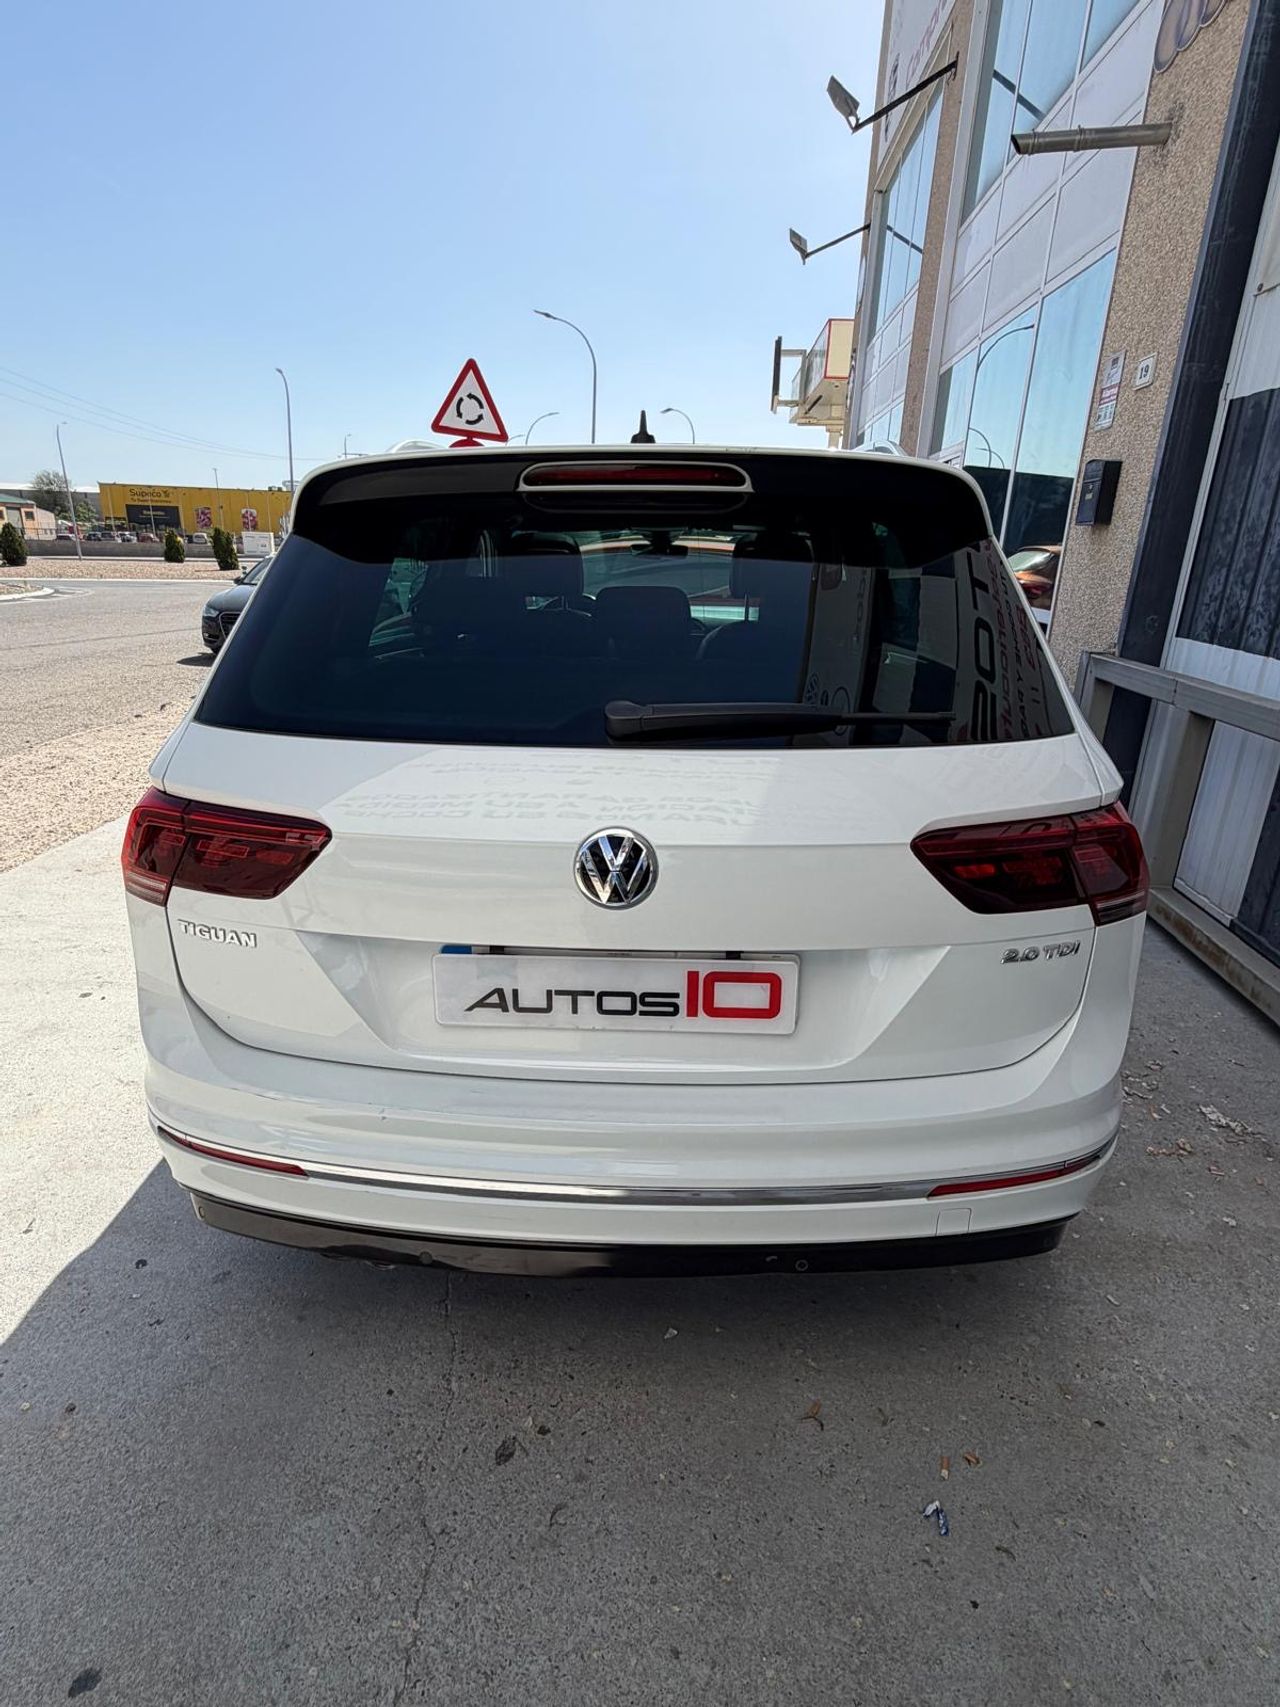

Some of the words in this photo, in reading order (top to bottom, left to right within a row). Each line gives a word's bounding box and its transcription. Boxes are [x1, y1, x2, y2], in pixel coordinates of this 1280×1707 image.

[1138, 363, 1150, 380] 19
[177, 918, 257, 948] TIGUAN
[1001, 946, 1040, 964] 2.0
[1042, 940, 1081, 960] TDI
